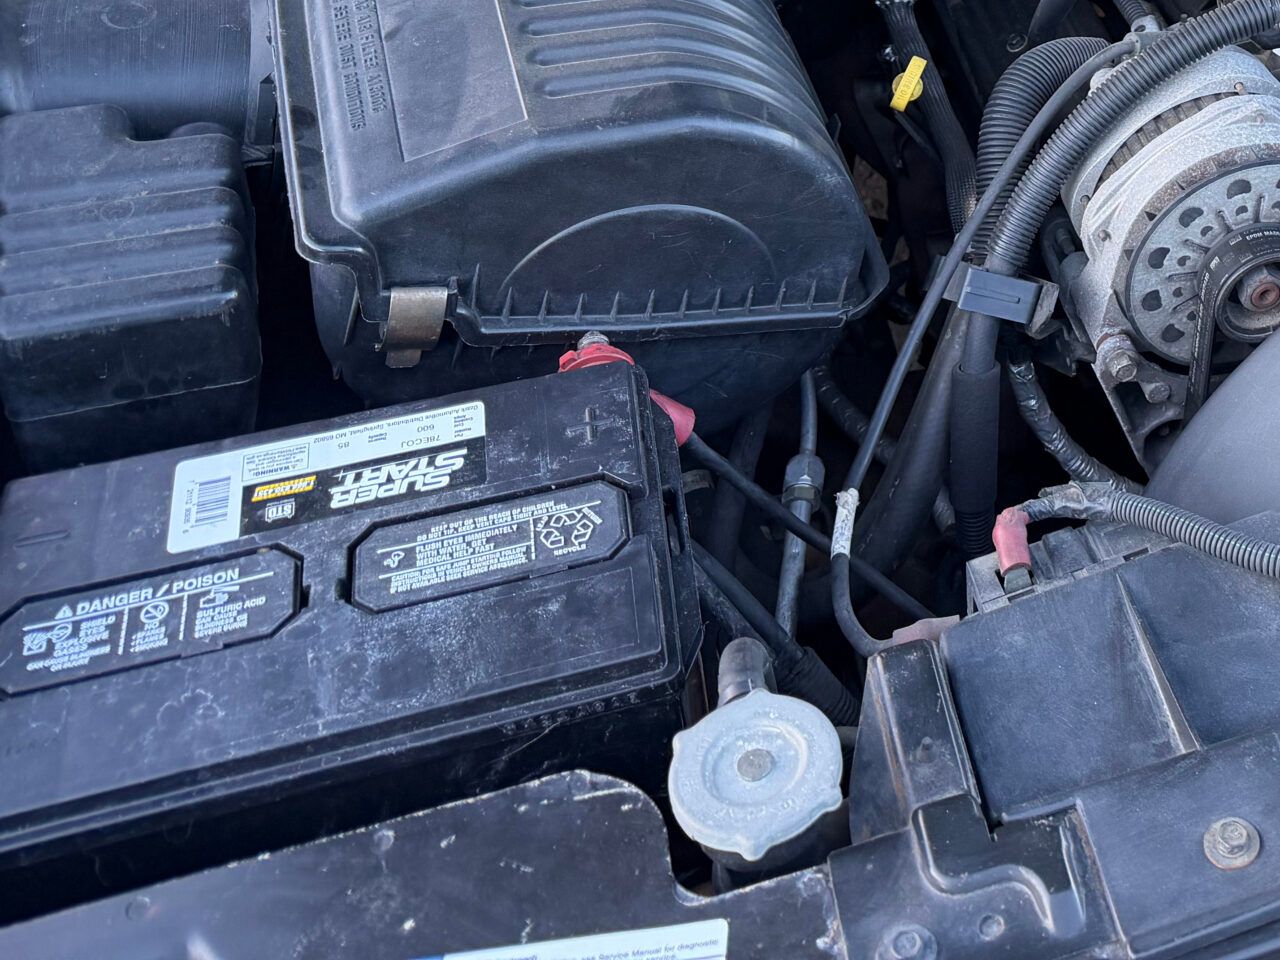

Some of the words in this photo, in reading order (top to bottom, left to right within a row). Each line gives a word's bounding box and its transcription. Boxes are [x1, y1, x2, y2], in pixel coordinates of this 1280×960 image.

[416, 424, 435, 433] 600
[328, 447, 468, 492] START
[333, 474, 451, 509] SUPER
[449, 520, 463, 528] OUT
[522, 500, 554, 513] CHILDREN
[416, 541, 441, 553] FLUSH
[443, 536, 463, 546] EYES
[464, 523, 517, 542] IMMEDIATELY
[416, 549, 437, 560] WITH
[471, 538, 486, 547] GET
[554, 543, 587, 556] RECYCLE
[416, 552, 451, 567] MEDICAL
[453, 547, 473, 558] HELP
[475, 543, 494, 553] FAST
[75, 585, 154, 616] DANGER
[172, 568, 240, 594] POISON
[196, 604, 243, 619] SULFURIC
[244, 596, 266, 609] ACID
[144, 621, 160, 631] NO
[631, 946, 662, 957] Manual
